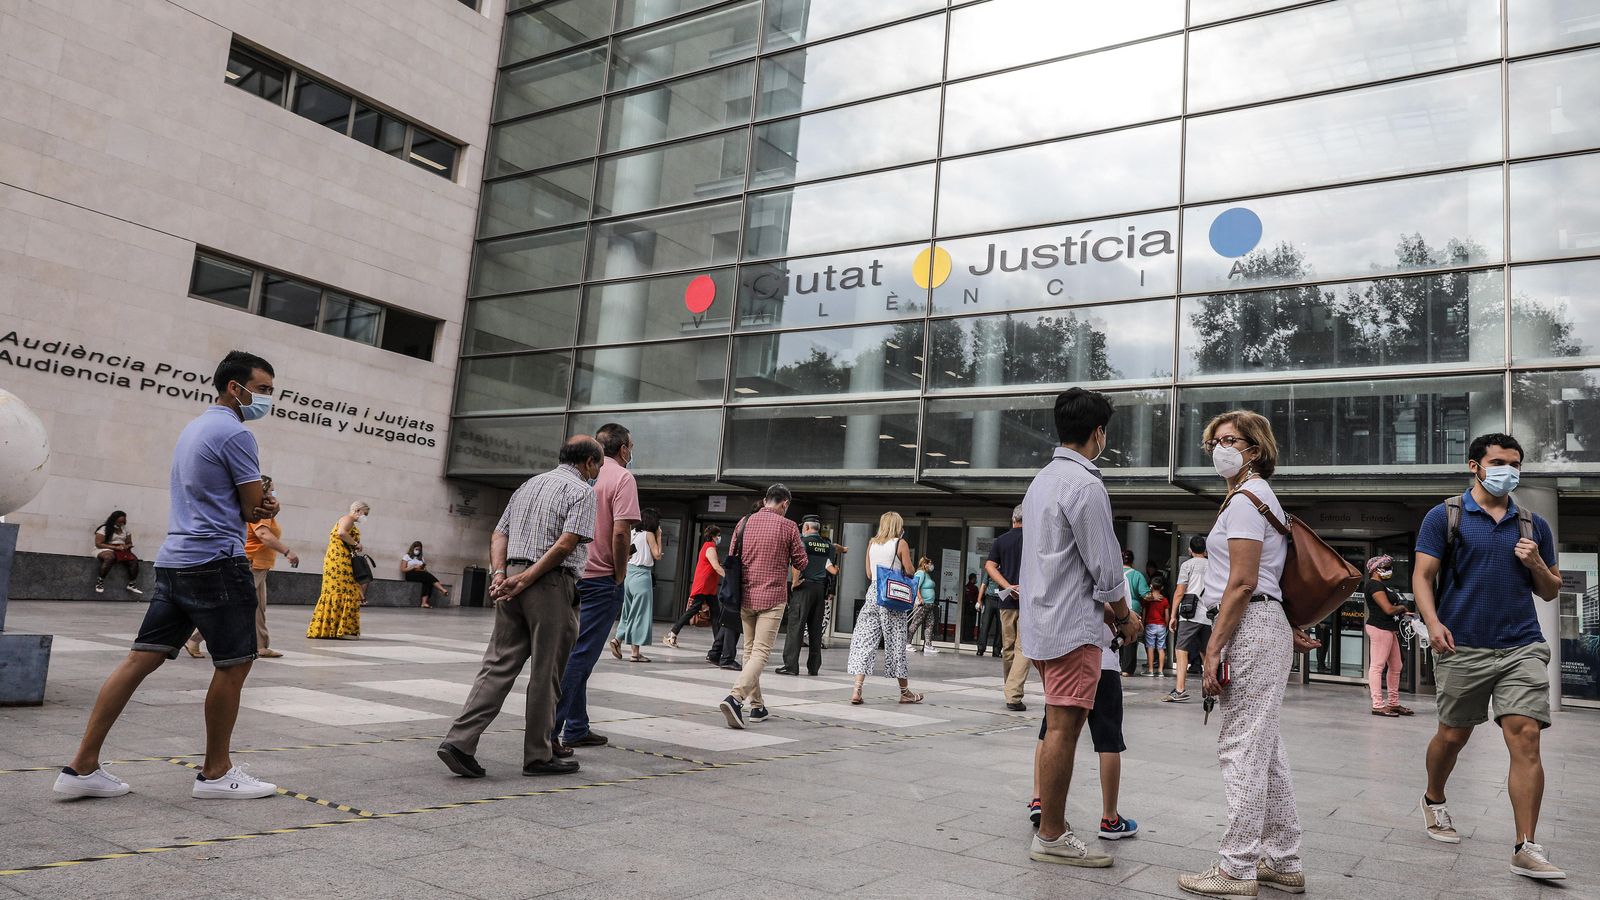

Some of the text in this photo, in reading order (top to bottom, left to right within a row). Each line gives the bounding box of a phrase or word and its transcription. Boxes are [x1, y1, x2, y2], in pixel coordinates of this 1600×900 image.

[752, 226, 1175, 300] Ciutat Justícia
[0, 331, 434, 432] Audiència Prov Fiscalia i Jutjats
[0, 350, 131, 388] Audiencia
[271, 404, 332, 427] iscalía
[338, 420, 349, 432] y
[354, 422, 436, 447] Juzgados
[1320, 512, 1351, 521] Entrada
